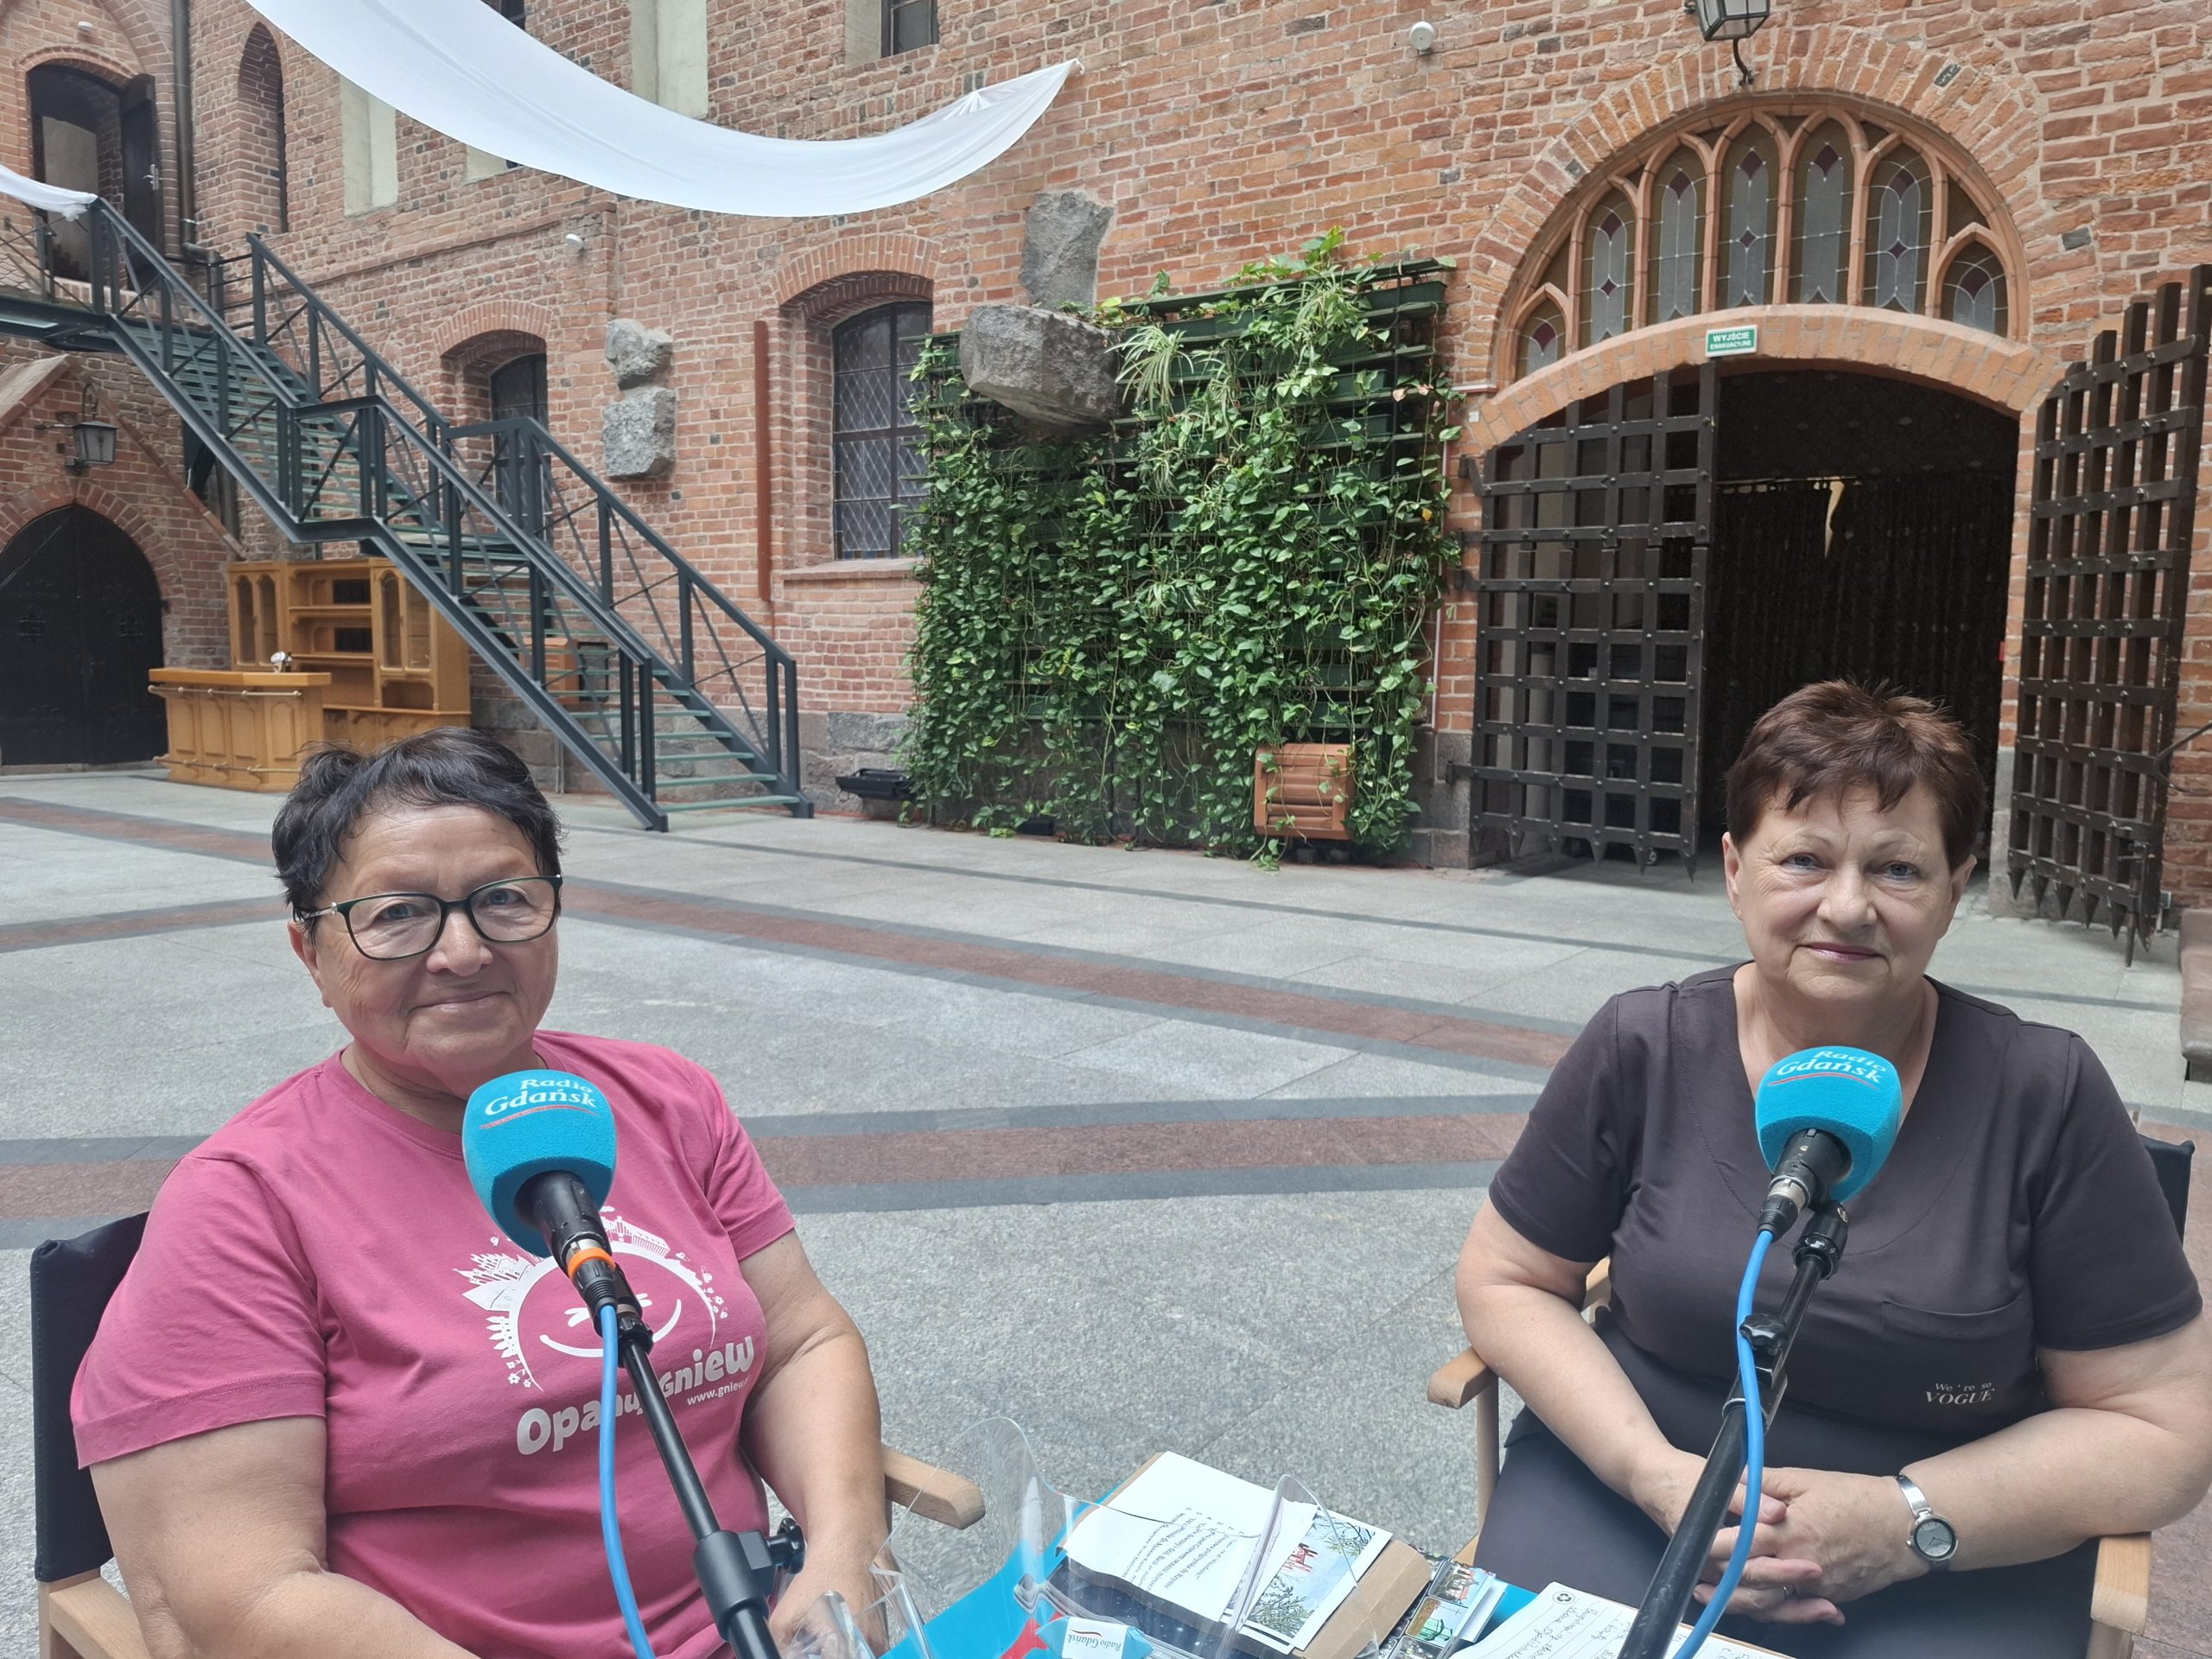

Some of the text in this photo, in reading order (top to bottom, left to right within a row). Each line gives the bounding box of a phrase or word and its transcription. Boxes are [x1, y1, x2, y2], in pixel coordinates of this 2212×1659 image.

[1713, 331, 1750, 342] WYJŚCIE
[1814, 1051, 1887, 1072] Radio
[1777, 1058, 1883, 1084] Gdańsk
[519, 1078, 594, 1094] Radio
[485, 1089, 597, 1116] Gdańsk
[1925, 1389, 1995, 1405] VOGUE
[1067, 1633, 1122, 1651] Radio Gdańsk
